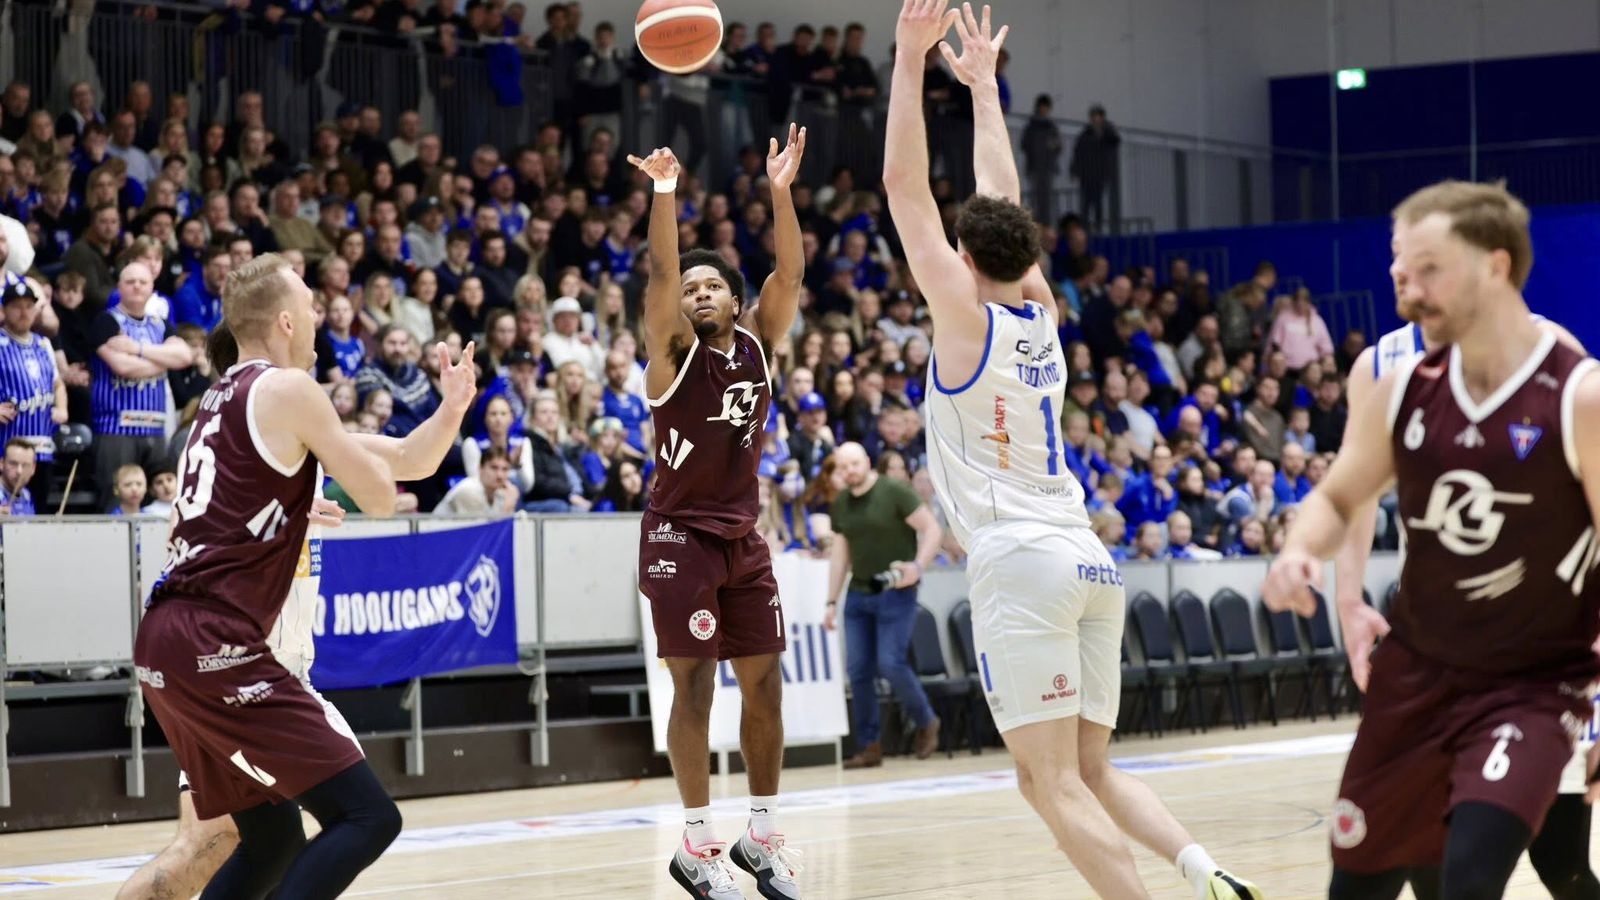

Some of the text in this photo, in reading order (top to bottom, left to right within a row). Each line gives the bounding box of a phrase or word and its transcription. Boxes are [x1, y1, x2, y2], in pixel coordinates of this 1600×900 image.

[995, 395, 1006, 430] PARTY
[1404, 408, 1426, 450] 6
[1039, 396, 1058, 475] 1
[333, 581, 465, 636] HOOLIGANS
[774, 610, 781, 638] 1
[980, 652, 992, 693] 1
[1482, 737, 1511, 781] 6
